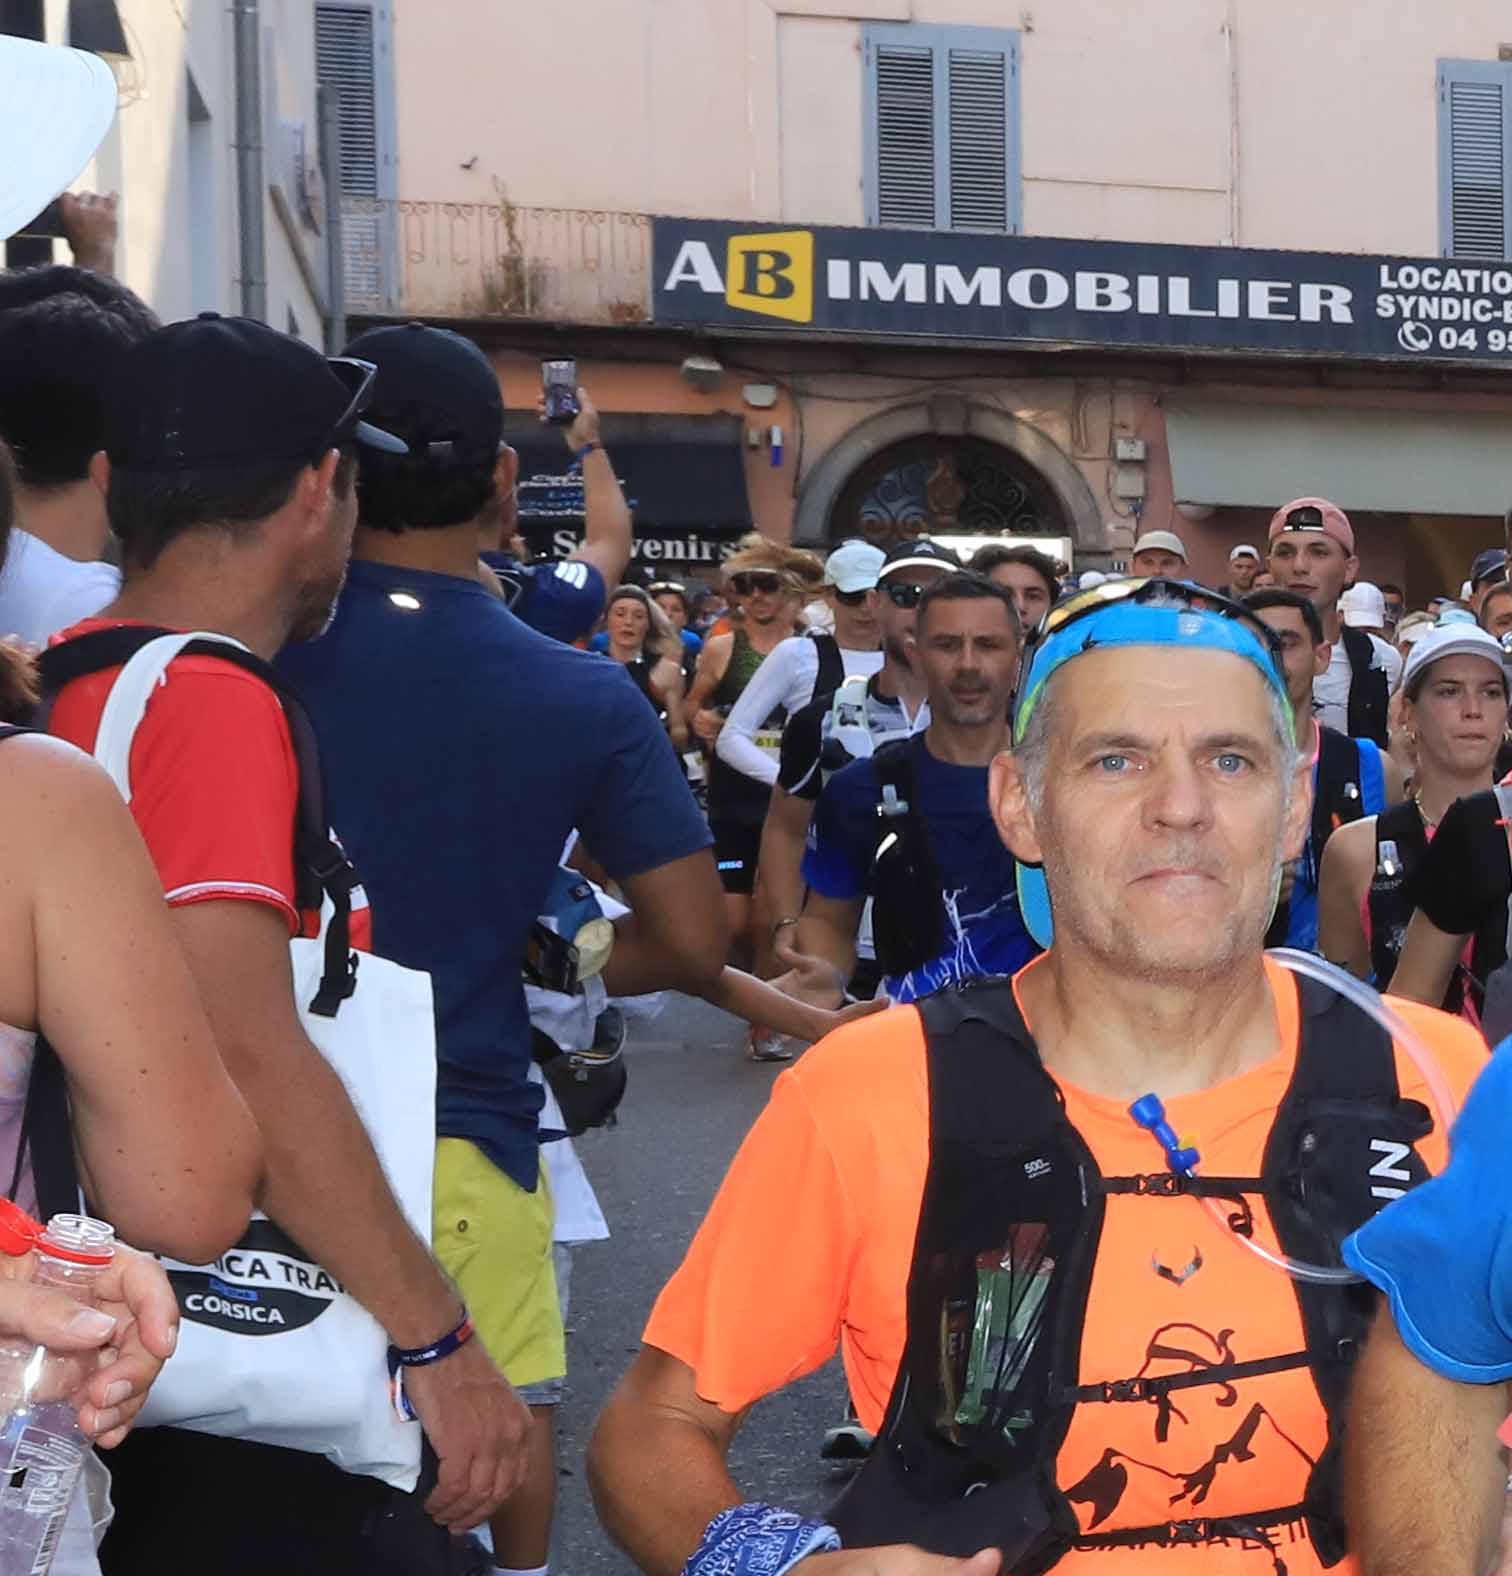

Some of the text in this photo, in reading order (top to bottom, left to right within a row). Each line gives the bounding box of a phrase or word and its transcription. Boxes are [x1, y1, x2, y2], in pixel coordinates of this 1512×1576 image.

[827, 259, 1354, 324] IMMOBILIER
[1439, 327, 1478, 351] 04
[185, 1293, 286, 1325] CORSICA
